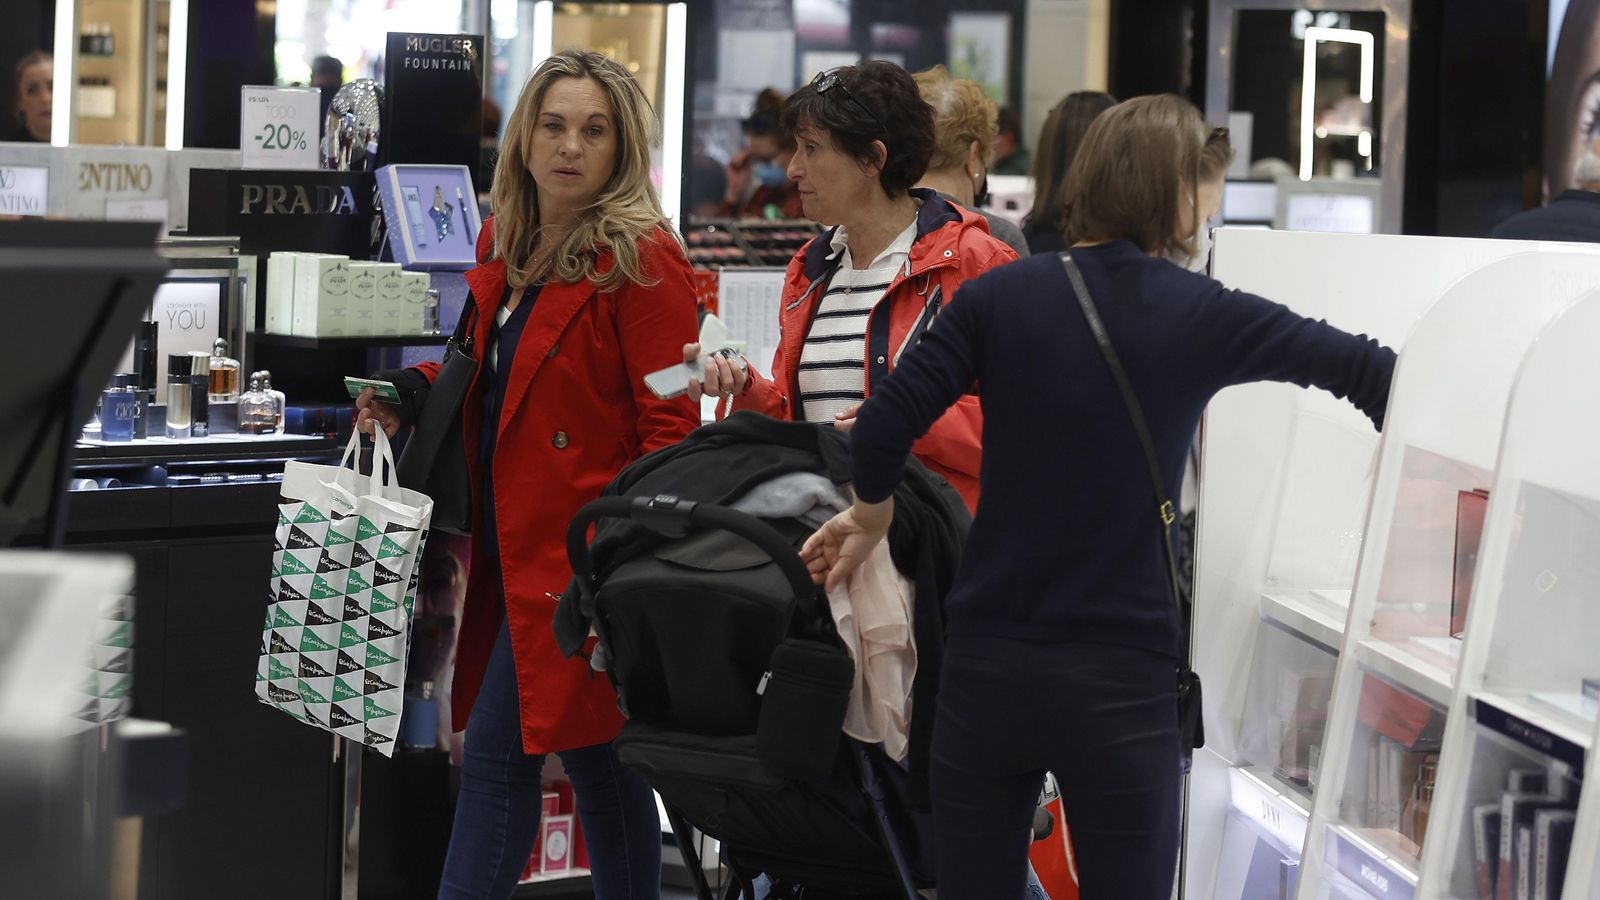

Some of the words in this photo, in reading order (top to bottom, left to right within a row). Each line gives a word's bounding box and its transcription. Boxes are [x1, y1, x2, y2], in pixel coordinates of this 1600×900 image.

[406, 36, 473, 54] MUGLER
[404, 57, 472, 71] FOUNTAIN
[255, 123, 307, 151] -20%
[240, 184, 358, 215] PRADA
[166, 309, 206, 331] YOU
